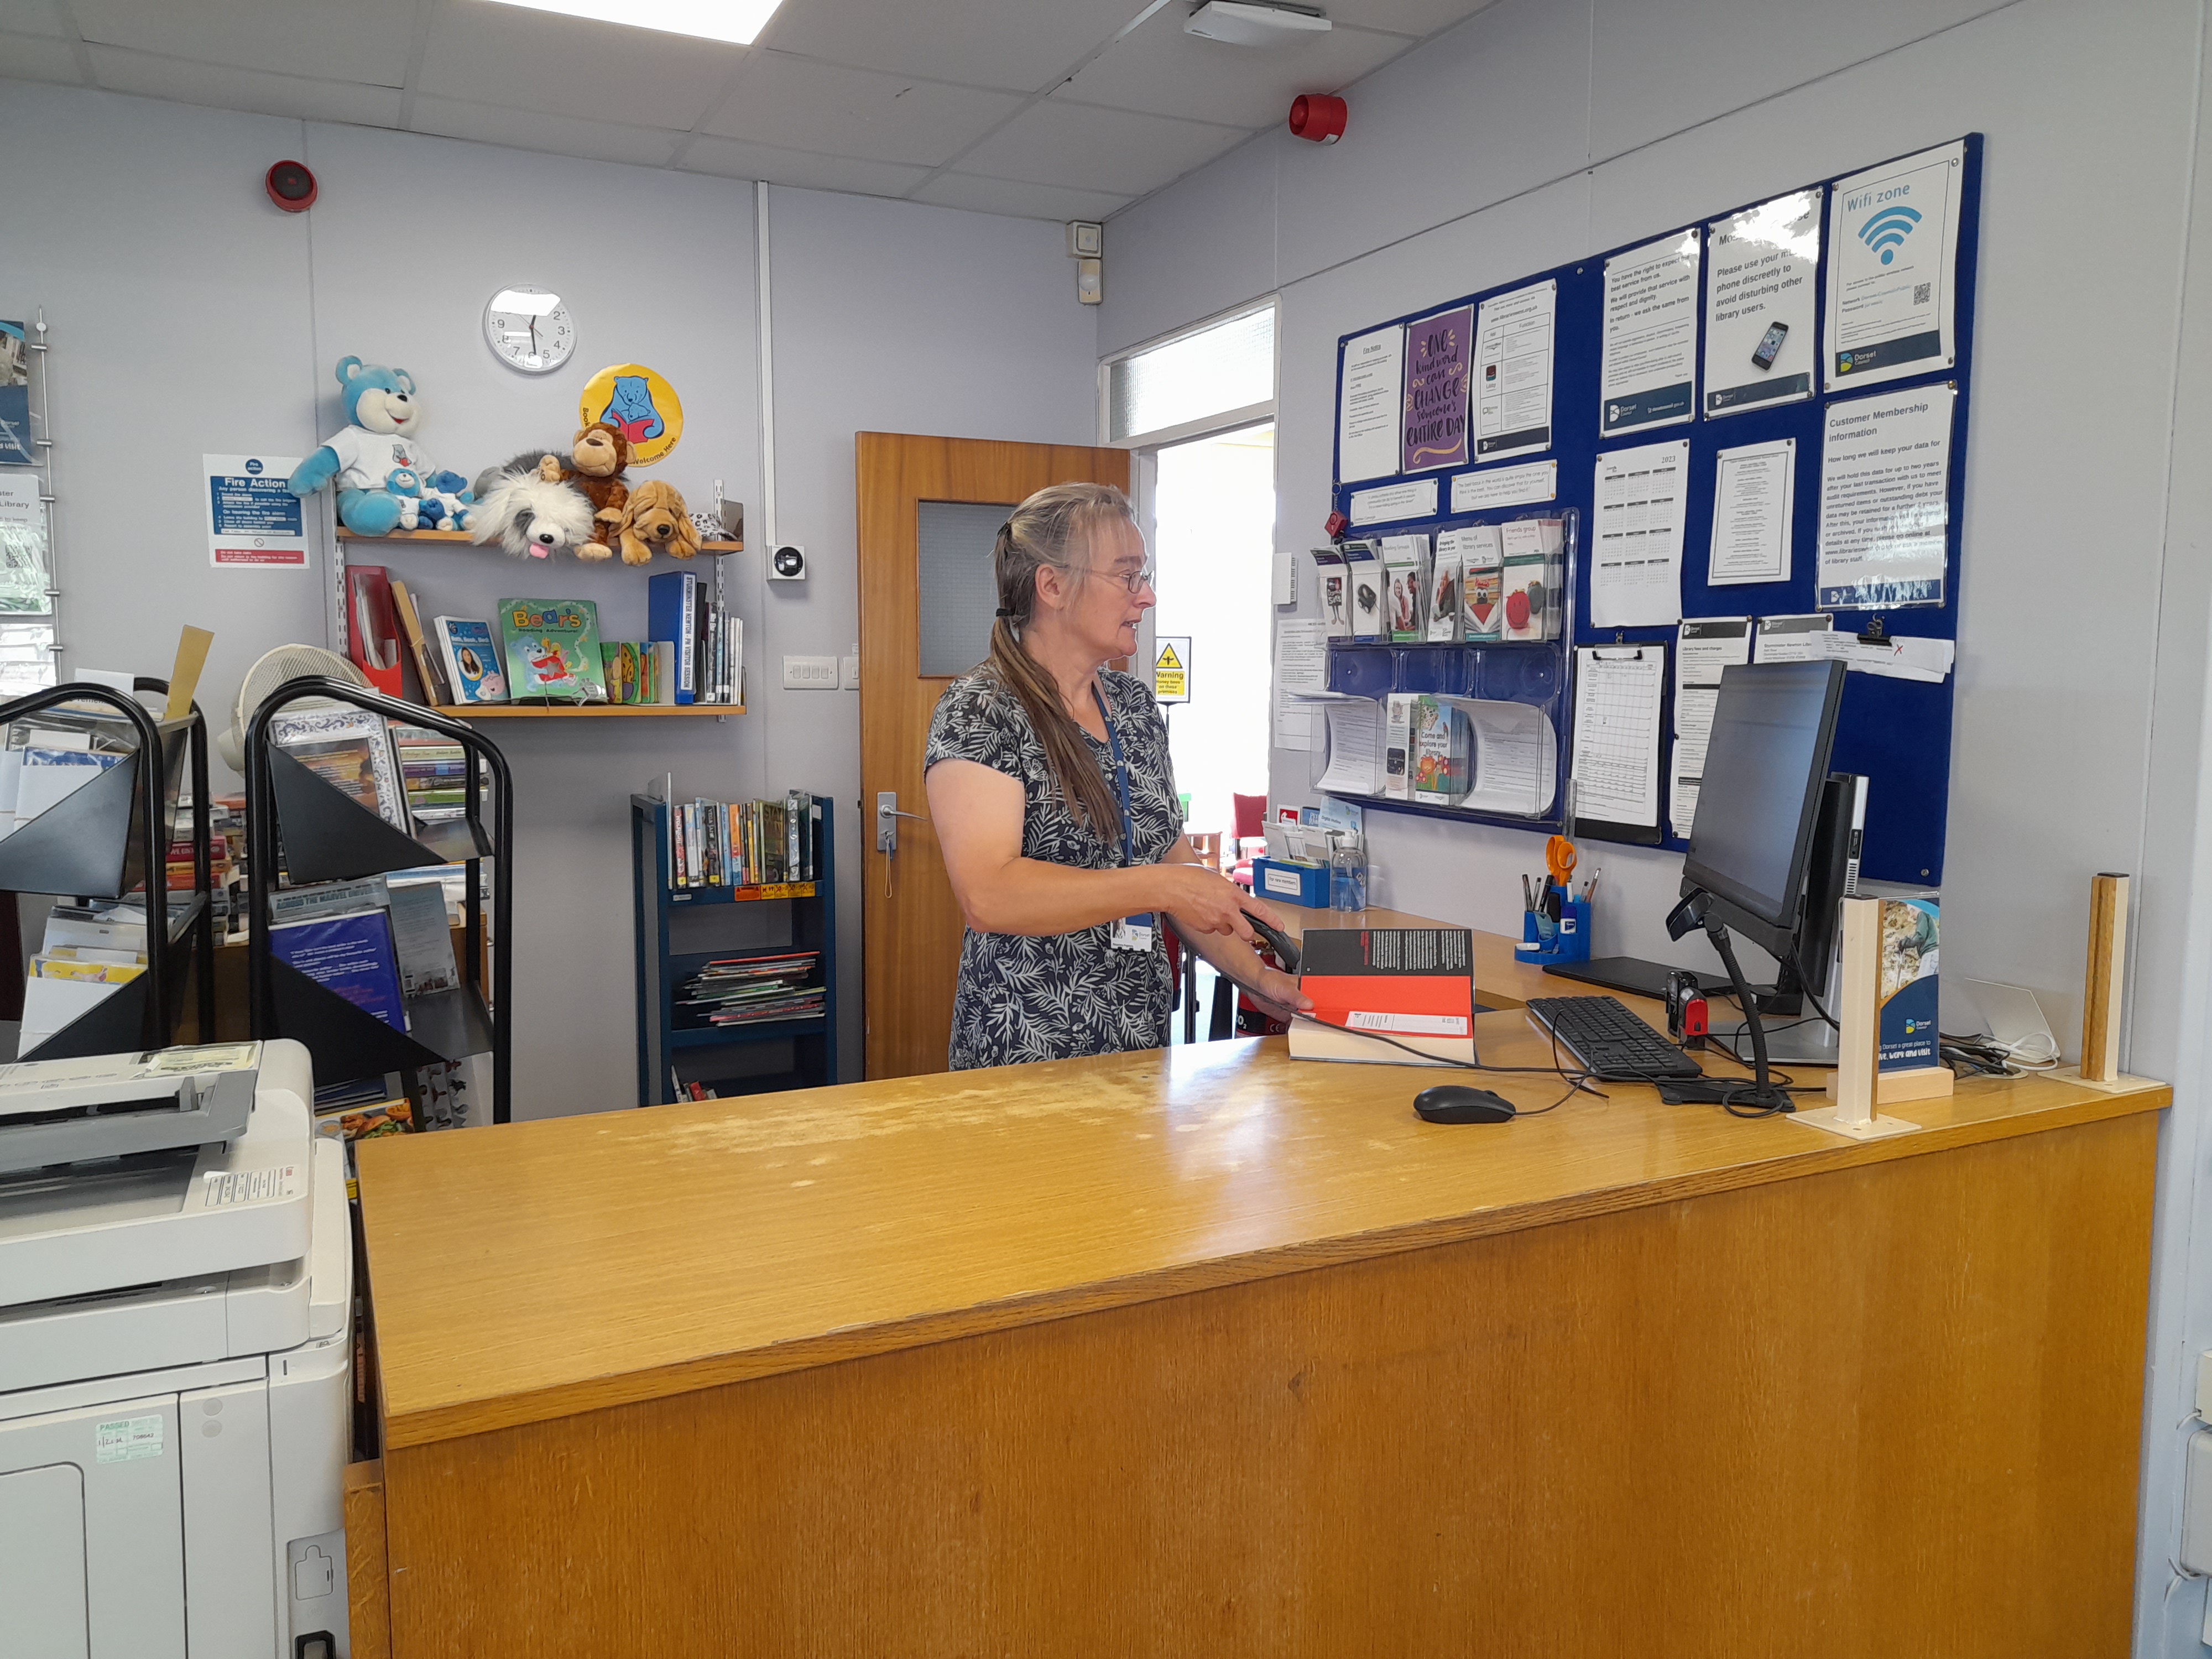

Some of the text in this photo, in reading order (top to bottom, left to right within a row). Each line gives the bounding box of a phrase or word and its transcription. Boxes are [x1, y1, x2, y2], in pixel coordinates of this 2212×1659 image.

[1848, 185, 1910, 212] Wifi zone
[1643, 265, 1654, 274] right
[1662, 257, 1679, 267] expect
[1718, 264, 1742, 278] Please
[1744, 259, 1758, 269] use
[1761, 253, 1779, 267] your
[1622, 278, 1639, 288] service
[1717, 265, 1791, 294] phone discreetly to
[1628, 289, 1646, 299] provide
[1659, 279, 1677, 289] service
[1716, 276, 1803, 307] avoid disturbing other
[1610, 302, 1627, 312] respect
[1715, 302, 1766, 321] library users.
[1841, 304, 1864, 313] Password
[554, 311, 560, 320] 2
[498, 319, 504, 328] 9
[557, 326, 565, 335] 3
[513, 346, 520, 355] 7
[554, 341, 561, 349] 4
[543, 349, 550, 359] 5
[1855, 351, 1876, 361] Dorset
[1416, 345, 1459, 375] kind word
[1426, 369, 1445, 385] can
[1417, 400, 1456, 423] someone's
[1620, 404, 1637, 412] Dorset
[1830, 403, 1928, 427] Customer Membership
[1446, 415, 1465, 436] DAY
[664, 437, 676, 452] Here
[1881, 447, 1896, 456] keep
[1898, 445, 1912, 453] your
[1661, 455, 1676, 463] 2023
[225, 478, 285, 488] Fire Action
[513, 609, 581, 627] Bear's
[100, 1421, 129, 1431] PASSED
